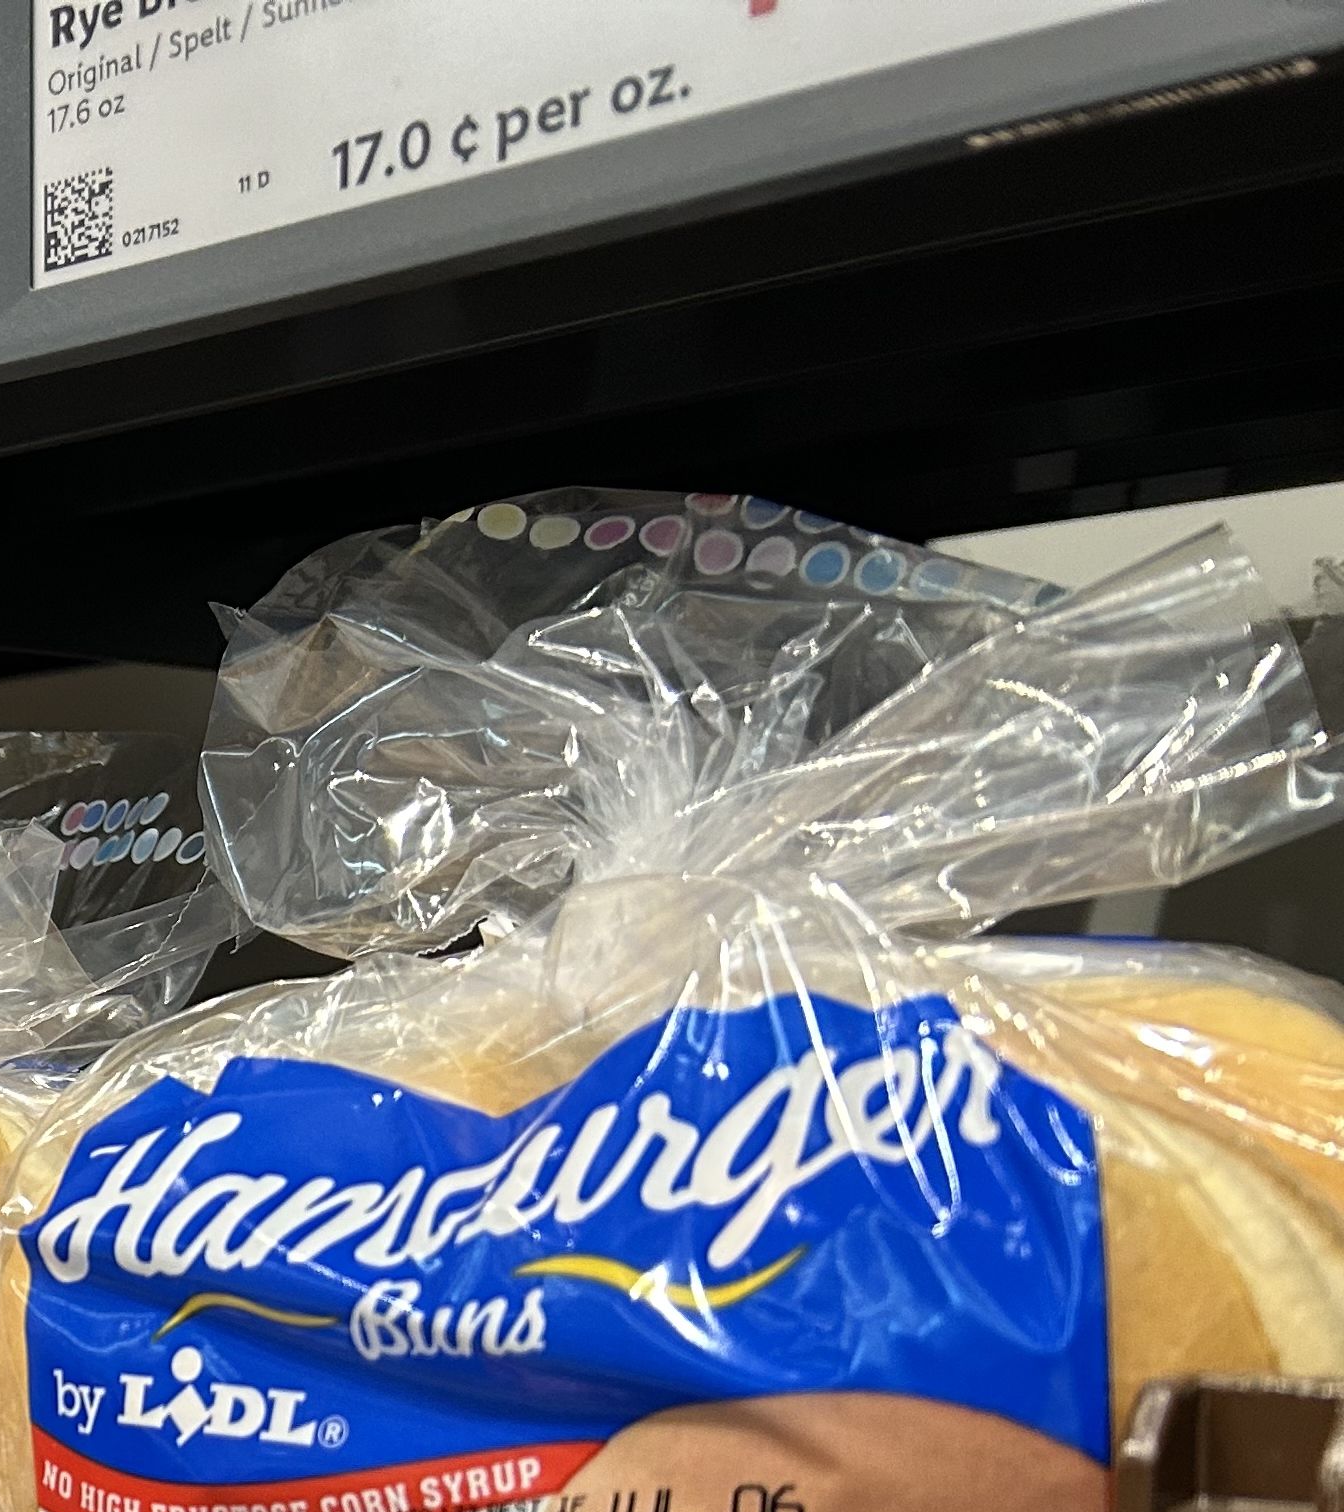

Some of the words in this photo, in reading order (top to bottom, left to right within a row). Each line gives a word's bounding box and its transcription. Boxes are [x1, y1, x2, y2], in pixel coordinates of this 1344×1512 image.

[49, 0, 124, 50] Rye
[48, 44, 141, 95] Original
[149, 33, 161, 71] /
[168, 15, 232, 61] Spelt
[47, 98, 90, 133] 17.6
[98, 95, 125, 118] oz
[331, 119, 431, 192] 17.0
[452, 115, 480, 163] ¢
[494, 84, 592, 161] per
[611, 63, 692, 116] oz.
[238, 175, 251, 194] 11
[257, 170, 271, 190] D
[121, 217, 180, 248] 0217152
[350, 1281, 545, 1361] Buns
[53, 1369, 106, 1434] by
[42, 1460, 72, 1499] NO
[420, 1456, 542, 1508] SYRUP
